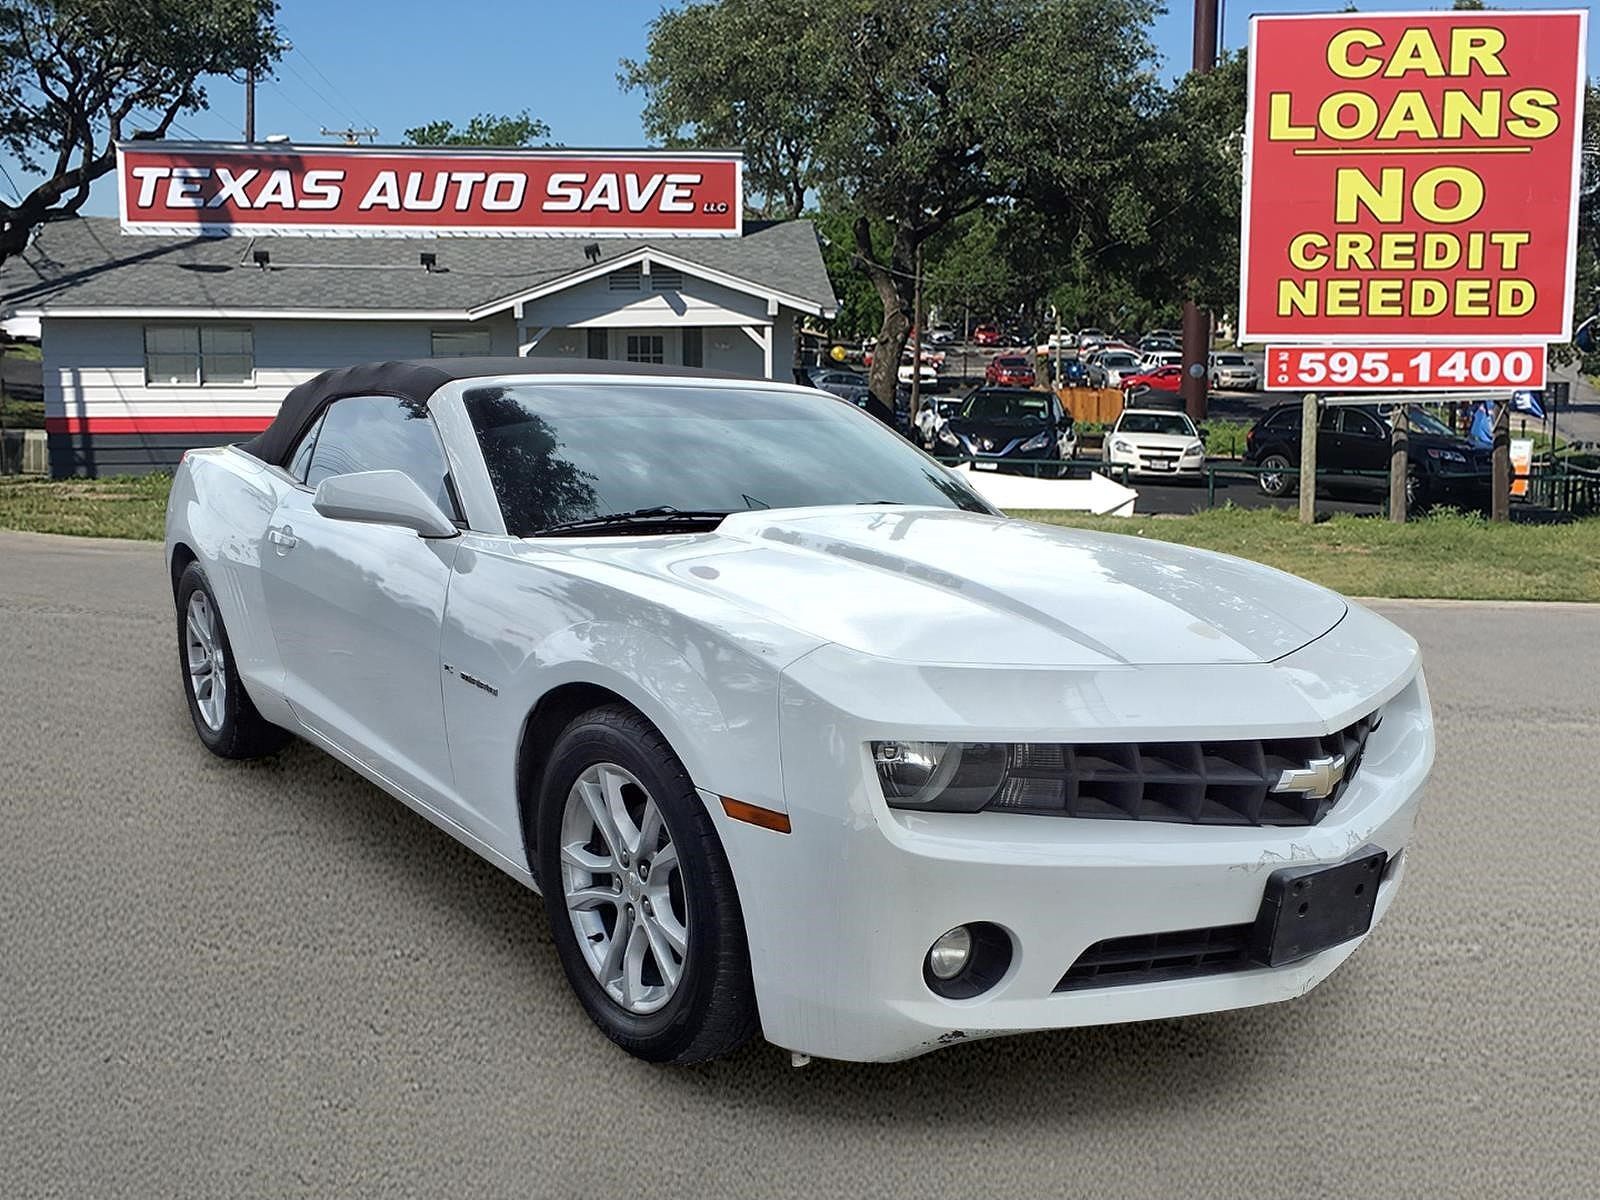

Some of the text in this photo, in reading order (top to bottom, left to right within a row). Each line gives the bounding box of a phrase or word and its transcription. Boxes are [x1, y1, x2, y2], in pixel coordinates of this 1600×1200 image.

[1326, 27, 1509, 79] CAR
[1269, 88, 1559, 141] LOANS
[132, 167, 728, 213] TEXAS AUTO SAVE LLC
[1335, 166, 1485, 224] NO
[1289, 232, 1530, 271] CREDIT
[1277, 279, 1537, 317] NEEDED
[1297, 351, 1533, 384] 595.1400
